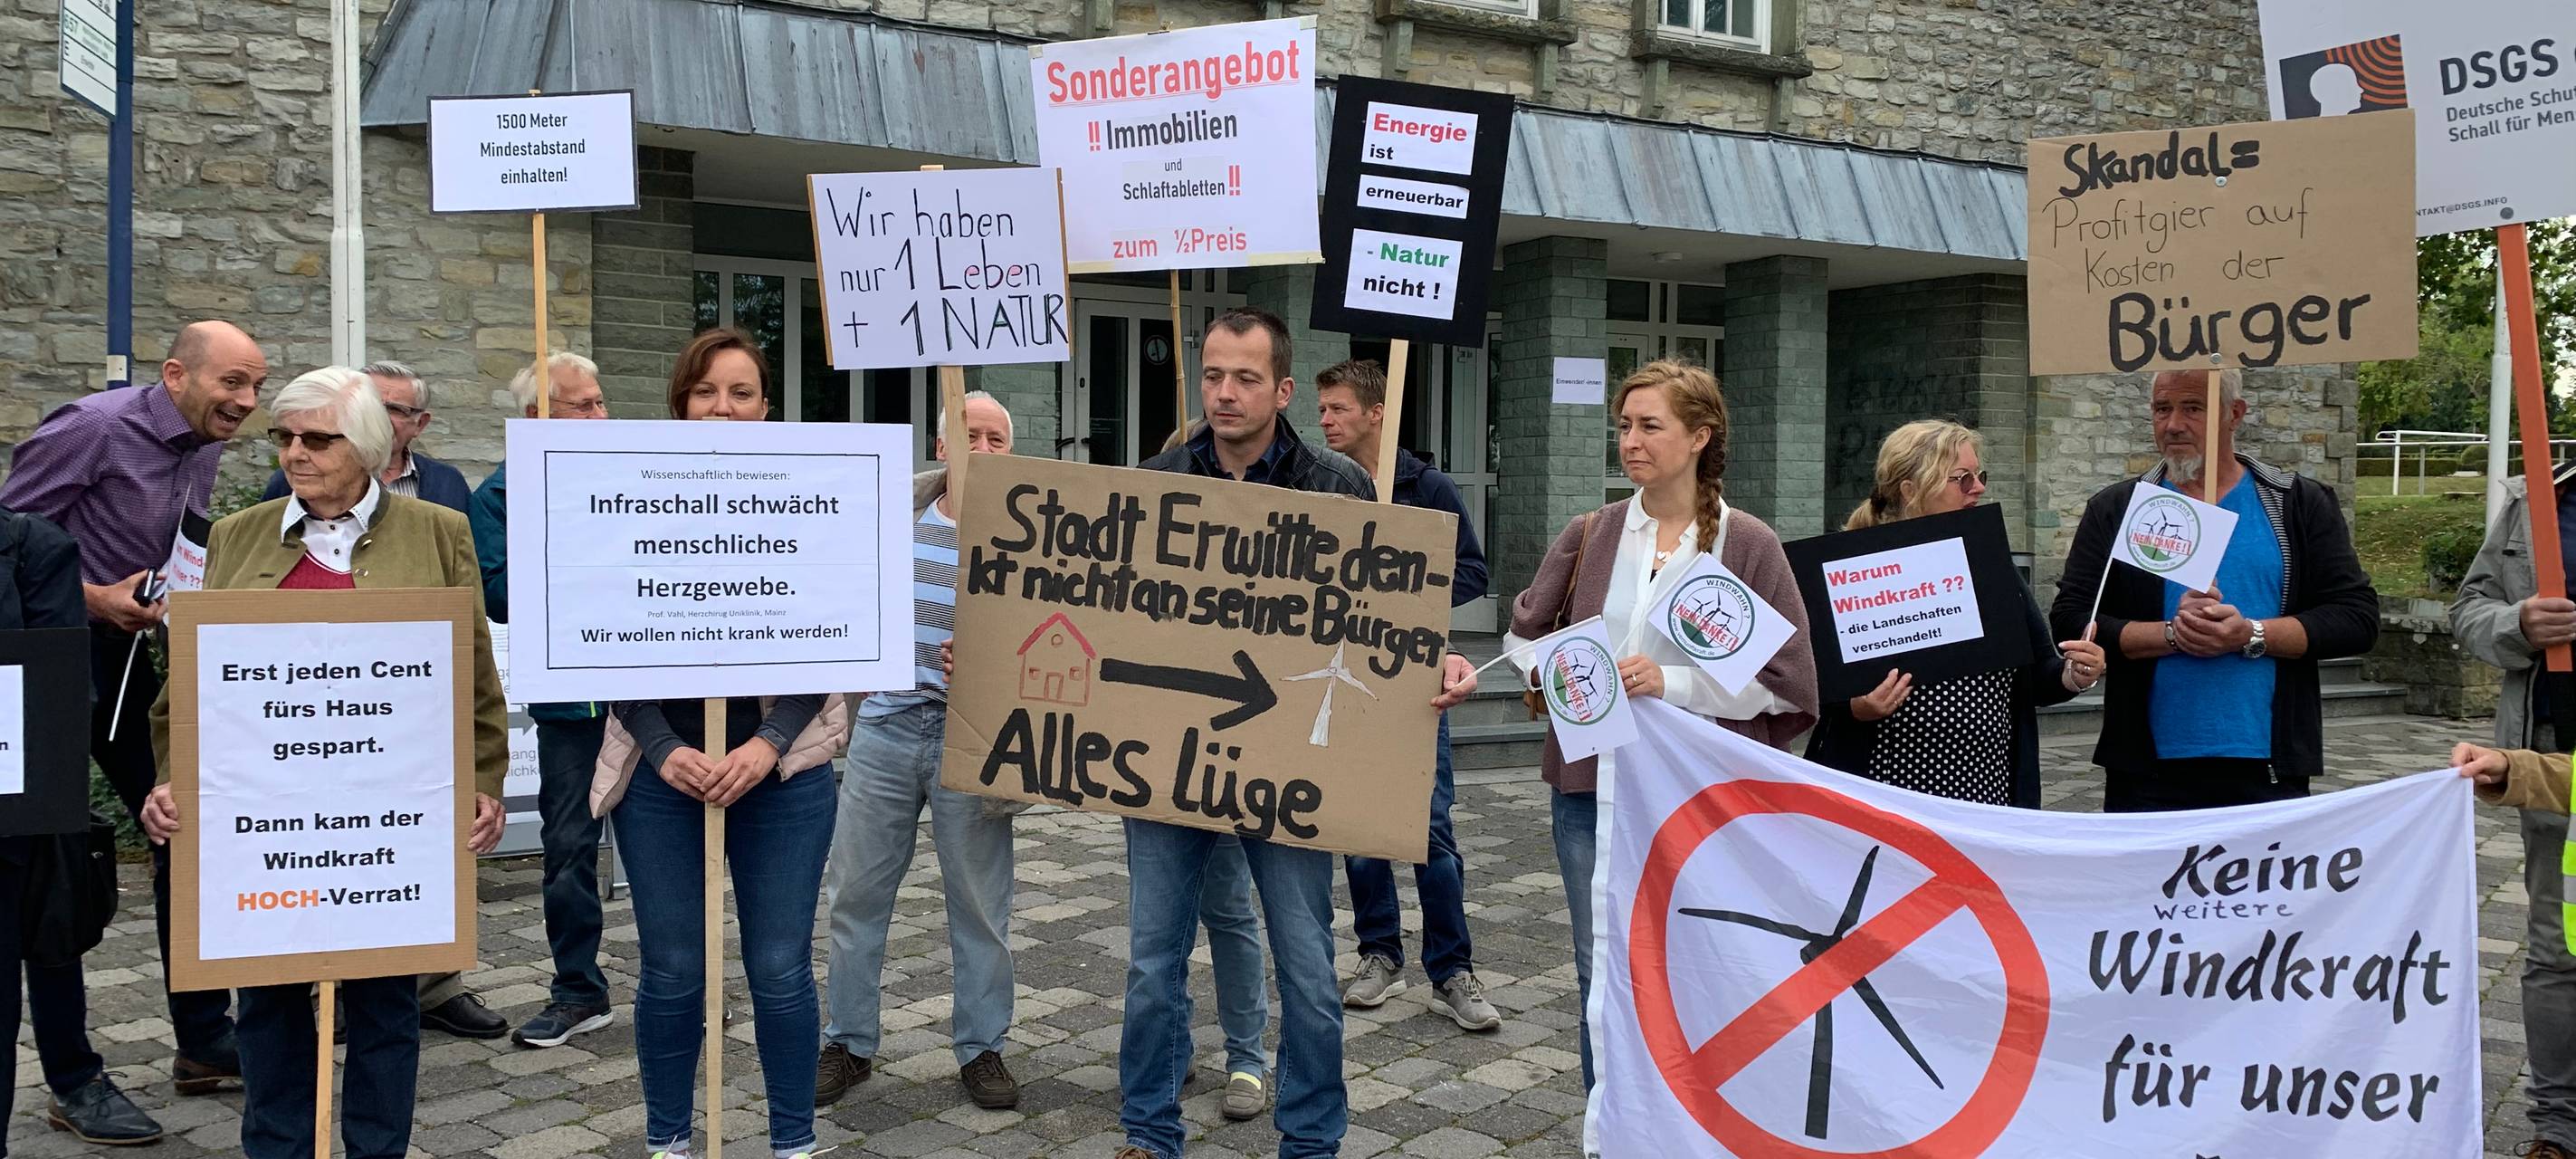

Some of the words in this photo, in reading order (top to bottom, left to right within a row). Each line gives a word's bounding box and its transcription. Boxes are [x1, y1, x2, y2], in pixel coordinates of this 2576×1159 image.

[1048, 41, 1298, 102] Sonderangebot
[2440, 39, 2559, 95] DSGS
[497, 114, 526, 129] 1500
[530, 113, 568, 128] Meter
[2447, 97, 2524, 121] Deutsche
[1089, 121, 1101, 151] !!
[1106, 110, 1237, 150] Immobilien
[1374, 113, 1466, 142] Energie
[2449, 119, 2501, 142] Schall
[2505, 116, 2531, 132] für
[481, 139, 585, 157] Mindestabstand
[1370, 144, 1393, 159] ist
[501, 168, 567, 184] einhalten!
[1165, 158, 1181, 171] und
[2059, 131, 2260, 197] Skandal=
[1123, 180, 1225, 200] Schlaftabletten
[1228, 166, 1240, 196] !!
[1367, 187, 1464, 207] erneuerbar
[827, 187, 894, 237] Wir
[913, 188, 1013, 237] haben
[2043, 197, 2215, 254] Profitgier
[2247, 187, 2313, 238] auf
[1113, 240, 1157, 258] zum
[1175, 226, 1246, 253] ½Preis
[1380, 243, 1449, 267] Natur
[841, 268, 885, 292] nur
[895, 238, 915, 290] 1
[936, 236, 1040, 290] Leben
[2085, 248, 2174, 293] Kosten
[2223, 251, 2284, 280] der
[1364, 275, 1425, 297] nicht
[1434, 283, 1440, 300] !
[844, 311, 868, 348] +
[901, 301, 924, 356] 1
[942, 293, 1068, 351] NATUR
[2110, 292, 2371, 372] Bürger
[641, 470, 732, 479] Wissenschaftlich
[737, 471, 790, 480] bewiesen:
[591, 493, 718, 513] Infraschall
[727, 494, 838, 513] schwächt
[2149, 499, 2190, 517] WINDWAHN
[634, 534, 797, 553] menschliches
[991, 484, 1145, 562] Stadt
[1157, 493, 1336, 581] Erwitte
[1340, 522, 1449, 594] den-
[2132, 532, 2152, 544] NEIN
[2154, 535, 2180, 551] DANKE
[1827, 564, 1901, 586] Warum
[638, 576, 795, 601] Herzgewebe.
[1706, 580, 1750, 611] WINDWAHN
[1834, 583, 1936, 618] Windkraft
[1942, 576, 1964, 592] ??
[968, 547, 1017, 595] kt
[1023, 559, 1139, 612] nicht
[1131, 580, 1188, 622] an
[1188, 582, 1308, 637] seine
[1312, 585, 1445, 678] Bürger
[1675, 604, 1700, 624] NEIN
[1698, 618, 1728, 644] DANKE
[1848, 625, 1868, 634] die
[1873, 607, 1961, 629] Landschaften
[581, 629, 612, 642] Wir
[618, 628, 674, 641] wollen
[682, 627, 722, 640] nicht
[730, 626, 775, 639] krank
[780, 624, 847, 638] werden!
[1852, 628, 1942, 654] verschandelt!
[223, 665, 277, 681] Erst
[286, 663, 360, 684] jeden
[371, 661, 432, 677] Cent
[1557, 654, 1569, 675] NEIN
[1565, 678, 1585, 710] DANKE
[1590, 645, 1614, 695] WINDWAHN
[263, 701, 315, 718] fürs
[327, 700, 392, 716] Haus
[274, 737, 383, 761] gespart.
[979, 708, 1151, 809] Alles
[1172, 727, 1321, 838] lüge
[236, 817, 303, 833] Dann
[315, 813, 369, 829] kam
[381, 810, 424, 827] der
[263, 848, 395, 869] Windkraft
[2162, 842, 2362, 898] Keine
[238, 884, 420, 910] HOCH-Verrat!
[2154, 900, 2293, 920] weitere
[2090, 928, 2450, 1024] Windkraft
[2103, 1033, 2210, 1123] für
[2241, 1064, 2439, 1123] unser
